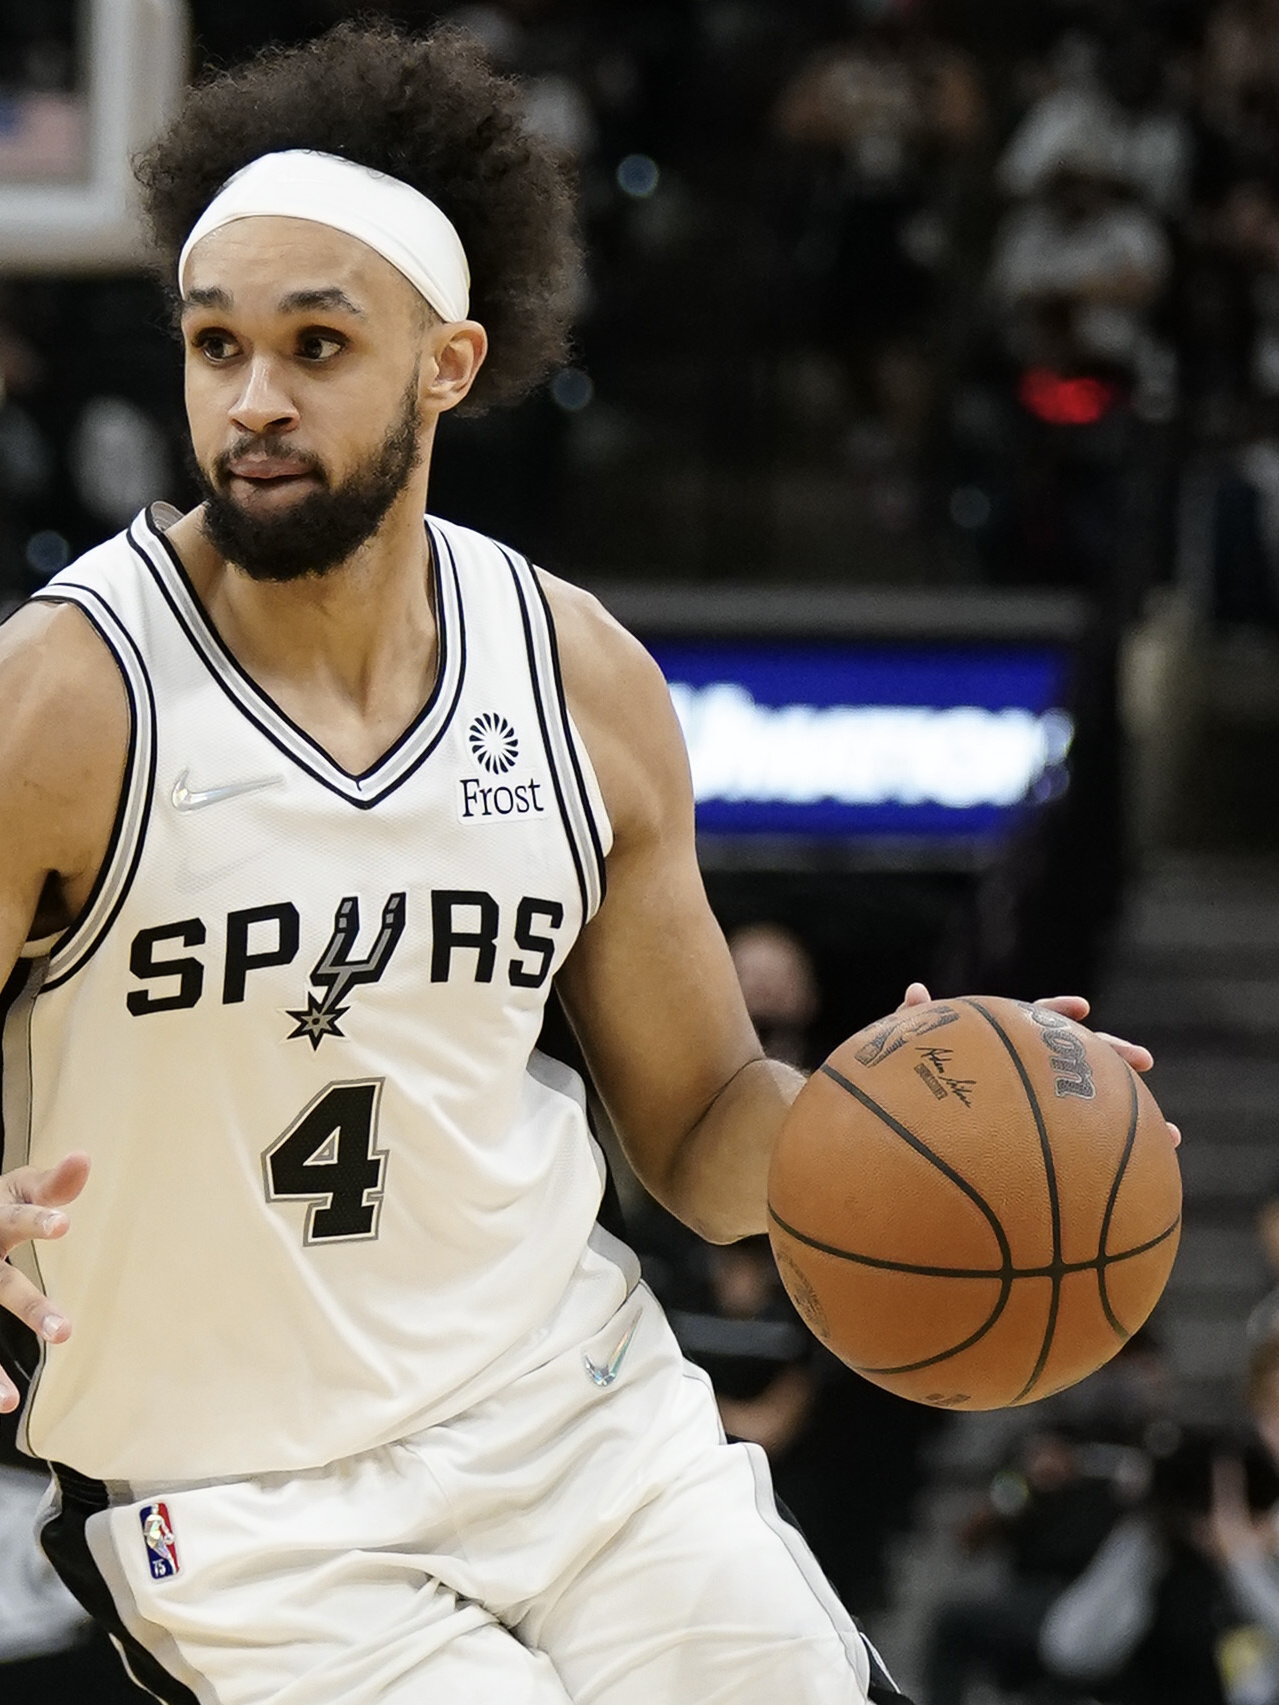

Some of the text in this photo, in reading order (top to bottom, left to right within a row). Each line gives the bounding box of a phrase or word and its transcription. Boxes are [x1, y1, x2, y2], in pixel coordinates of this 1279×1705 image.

[459, 778, 544, 817] Frost
[126, 890, 563, 1051] SPURS
[260, 1077, 389, 1247] 4
